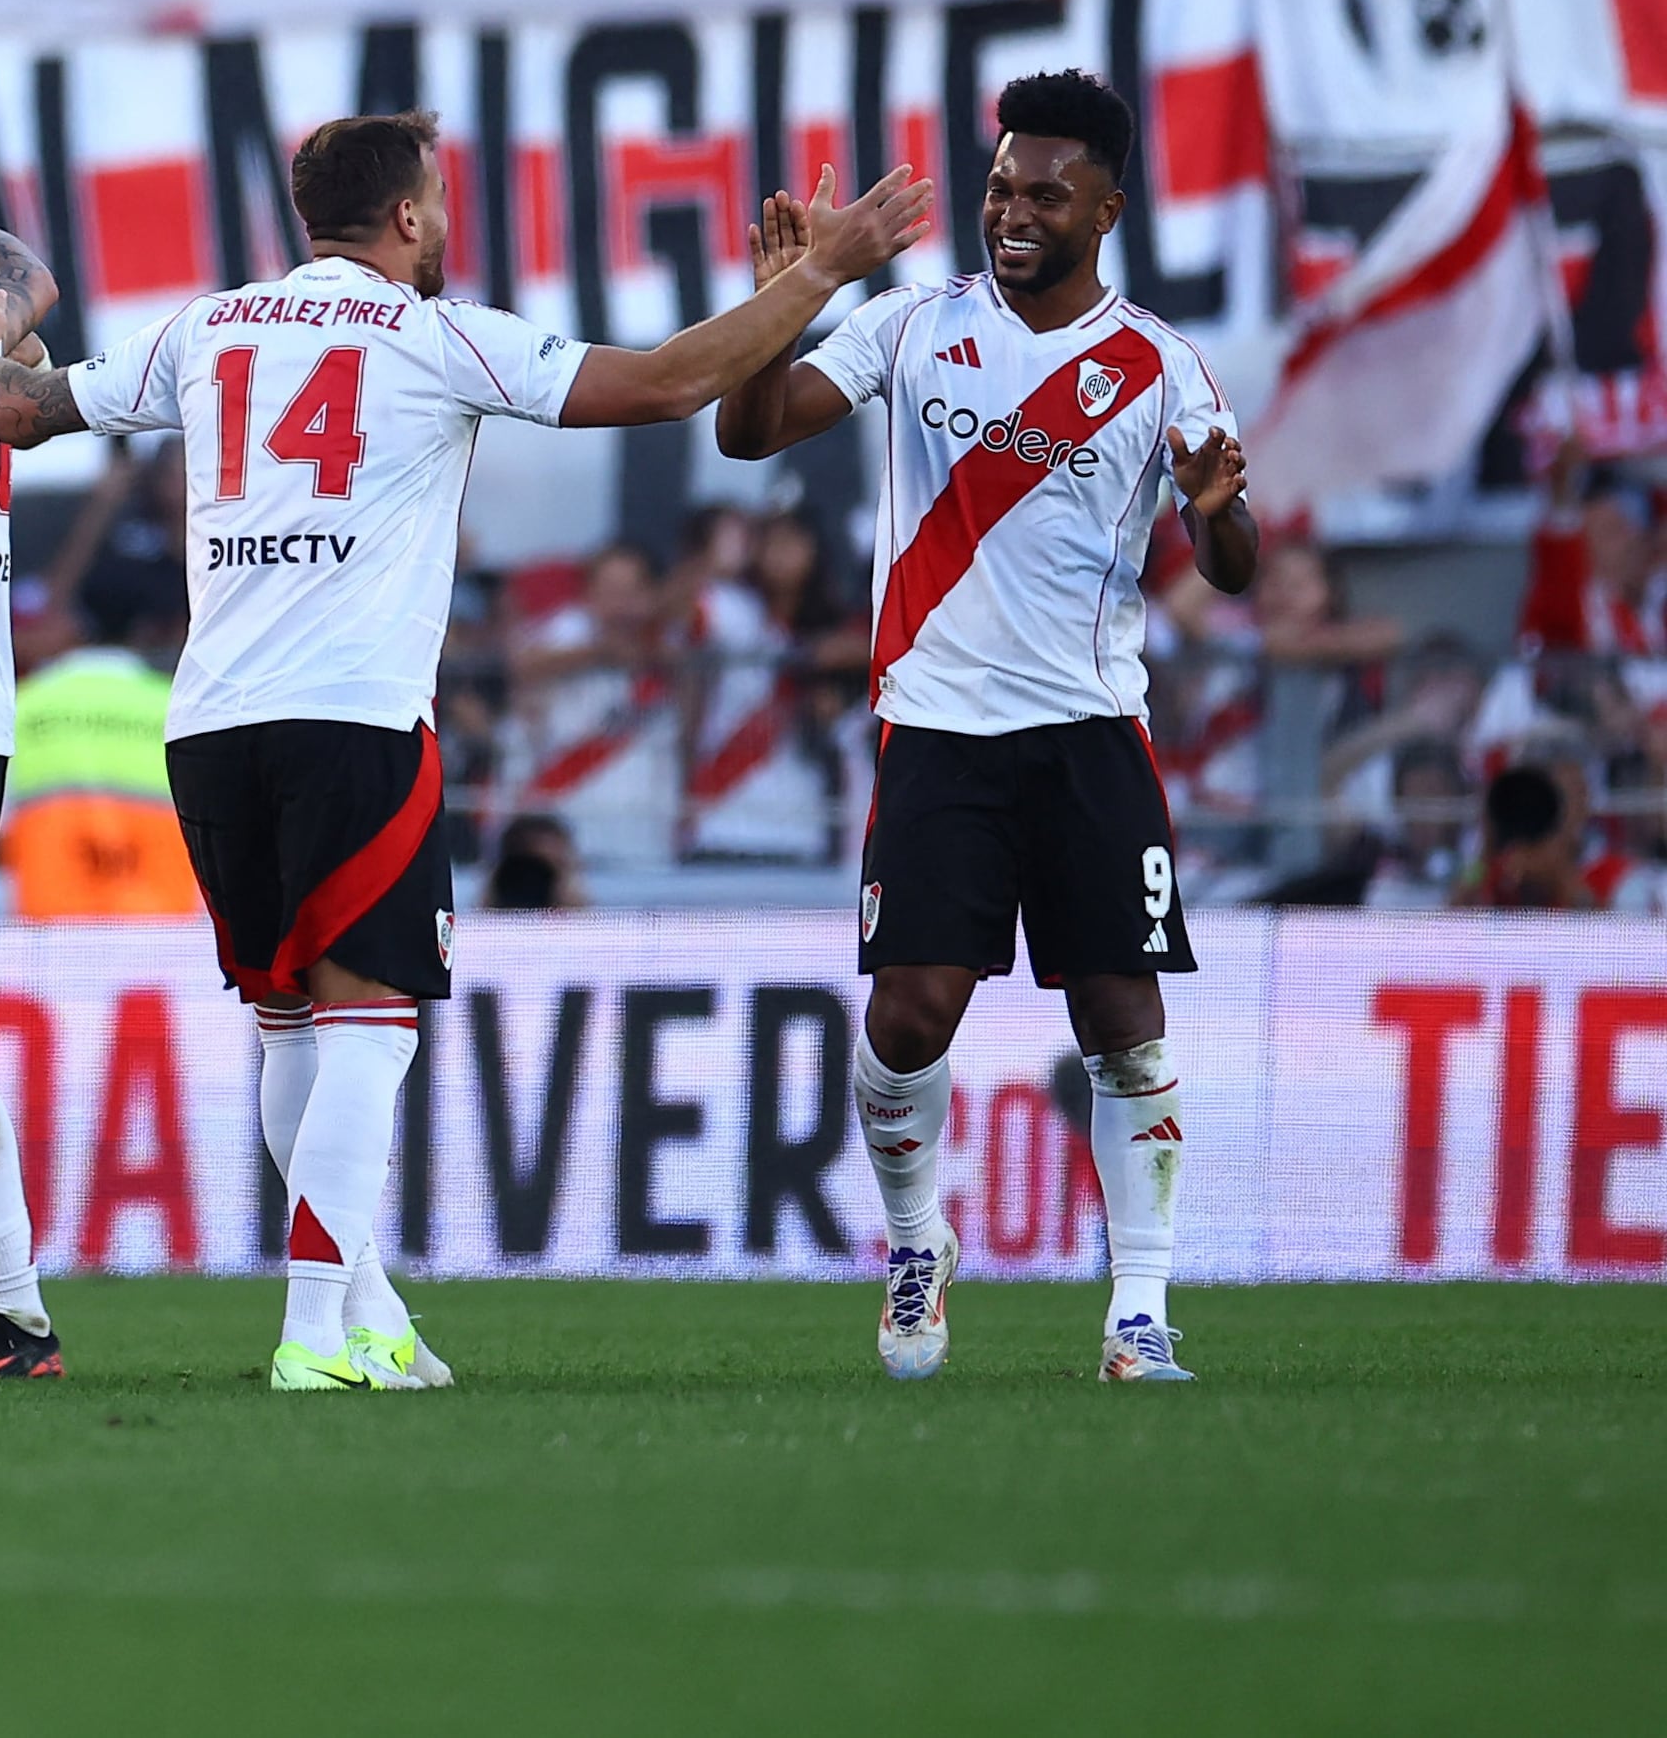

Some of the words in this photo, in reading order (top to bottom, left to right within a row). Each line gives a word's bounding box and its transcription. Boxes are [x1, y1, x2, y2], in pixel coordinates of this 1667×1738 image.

[210, 344, 367, 502] 14
[920, 397, 1100, 479] codere
[208, 534, 357, 572] DIRECTV
[1141, 845, 1173, 919] 9
[262, 976, 857, 1261] IVER
[866, 1100, 914, 1120] CARP
